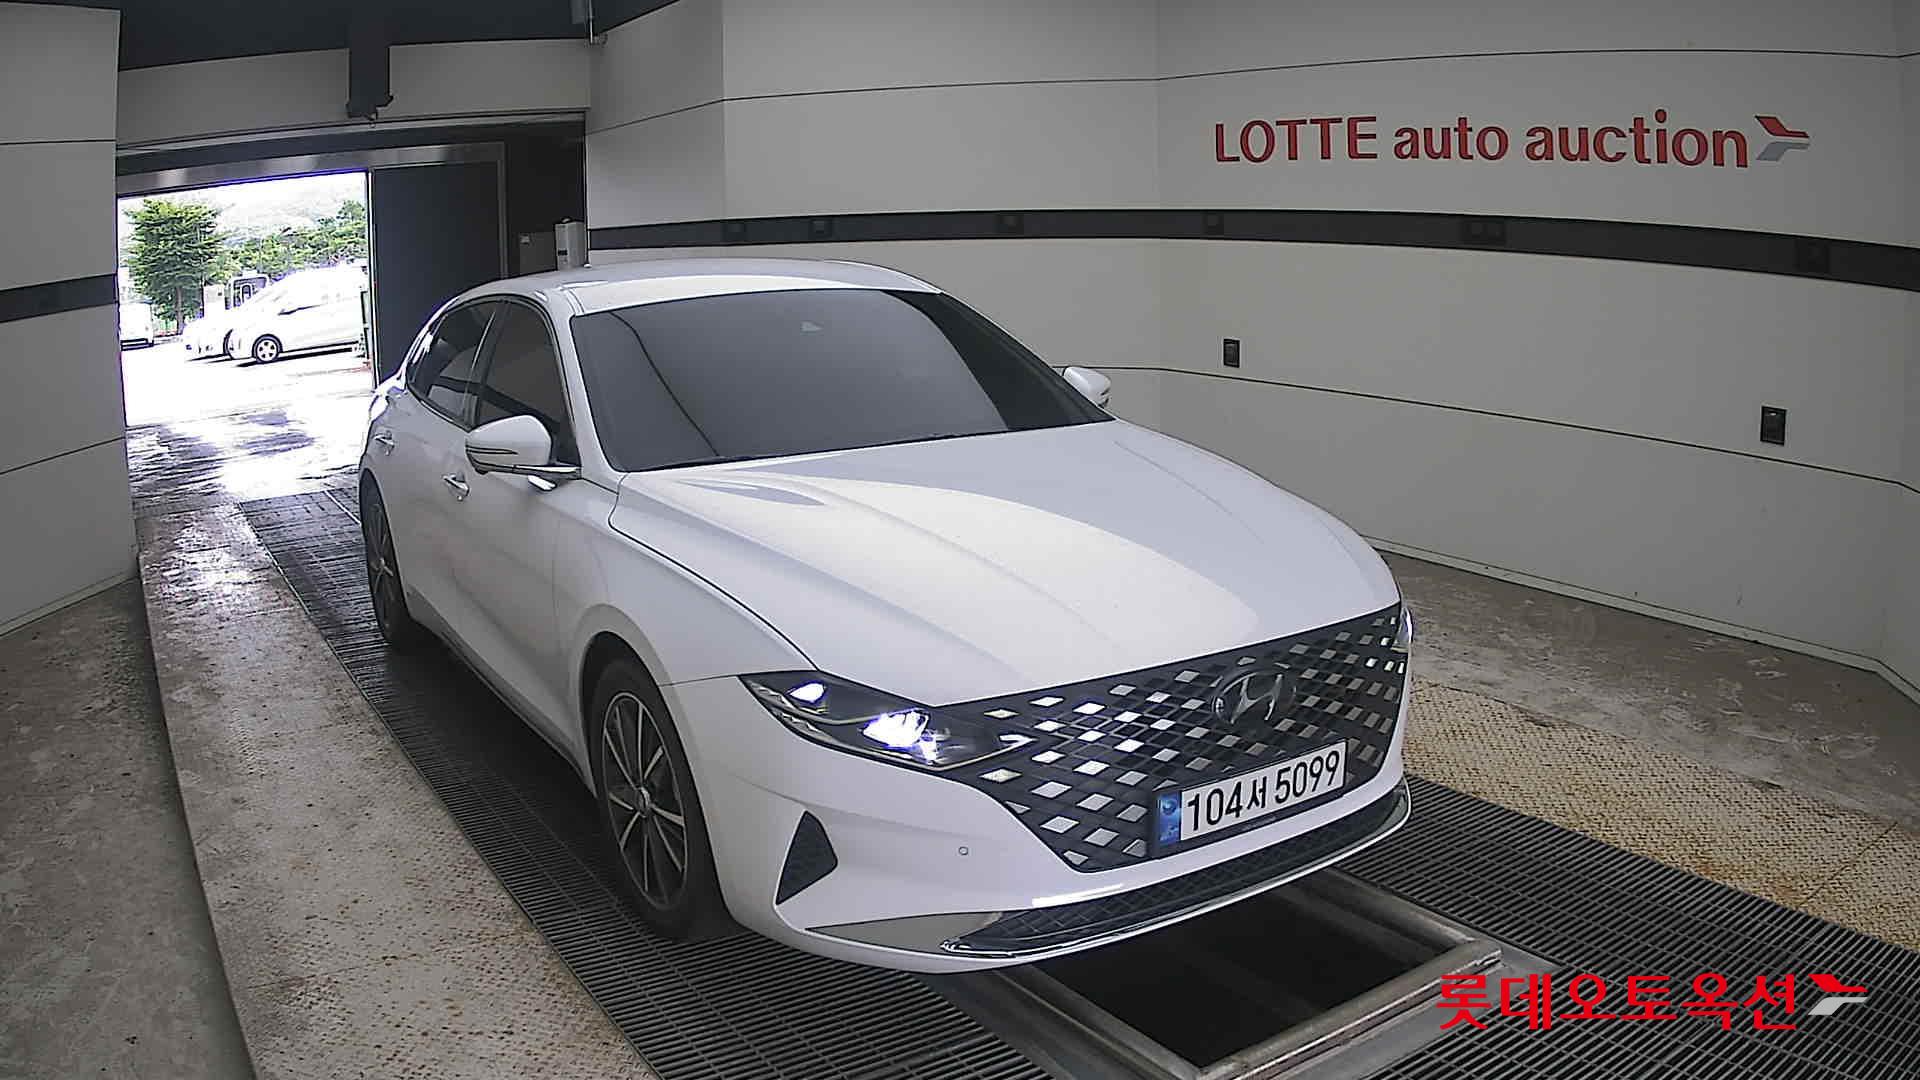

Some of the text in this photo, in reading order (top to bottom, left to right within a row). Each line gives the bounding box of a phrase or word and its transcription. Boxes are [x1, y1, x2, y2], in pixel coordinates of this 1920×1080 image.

[1215, 109, 1749, 168] LOTTE auto auction
[1187, 751, 1340, 831] 104서 5099
